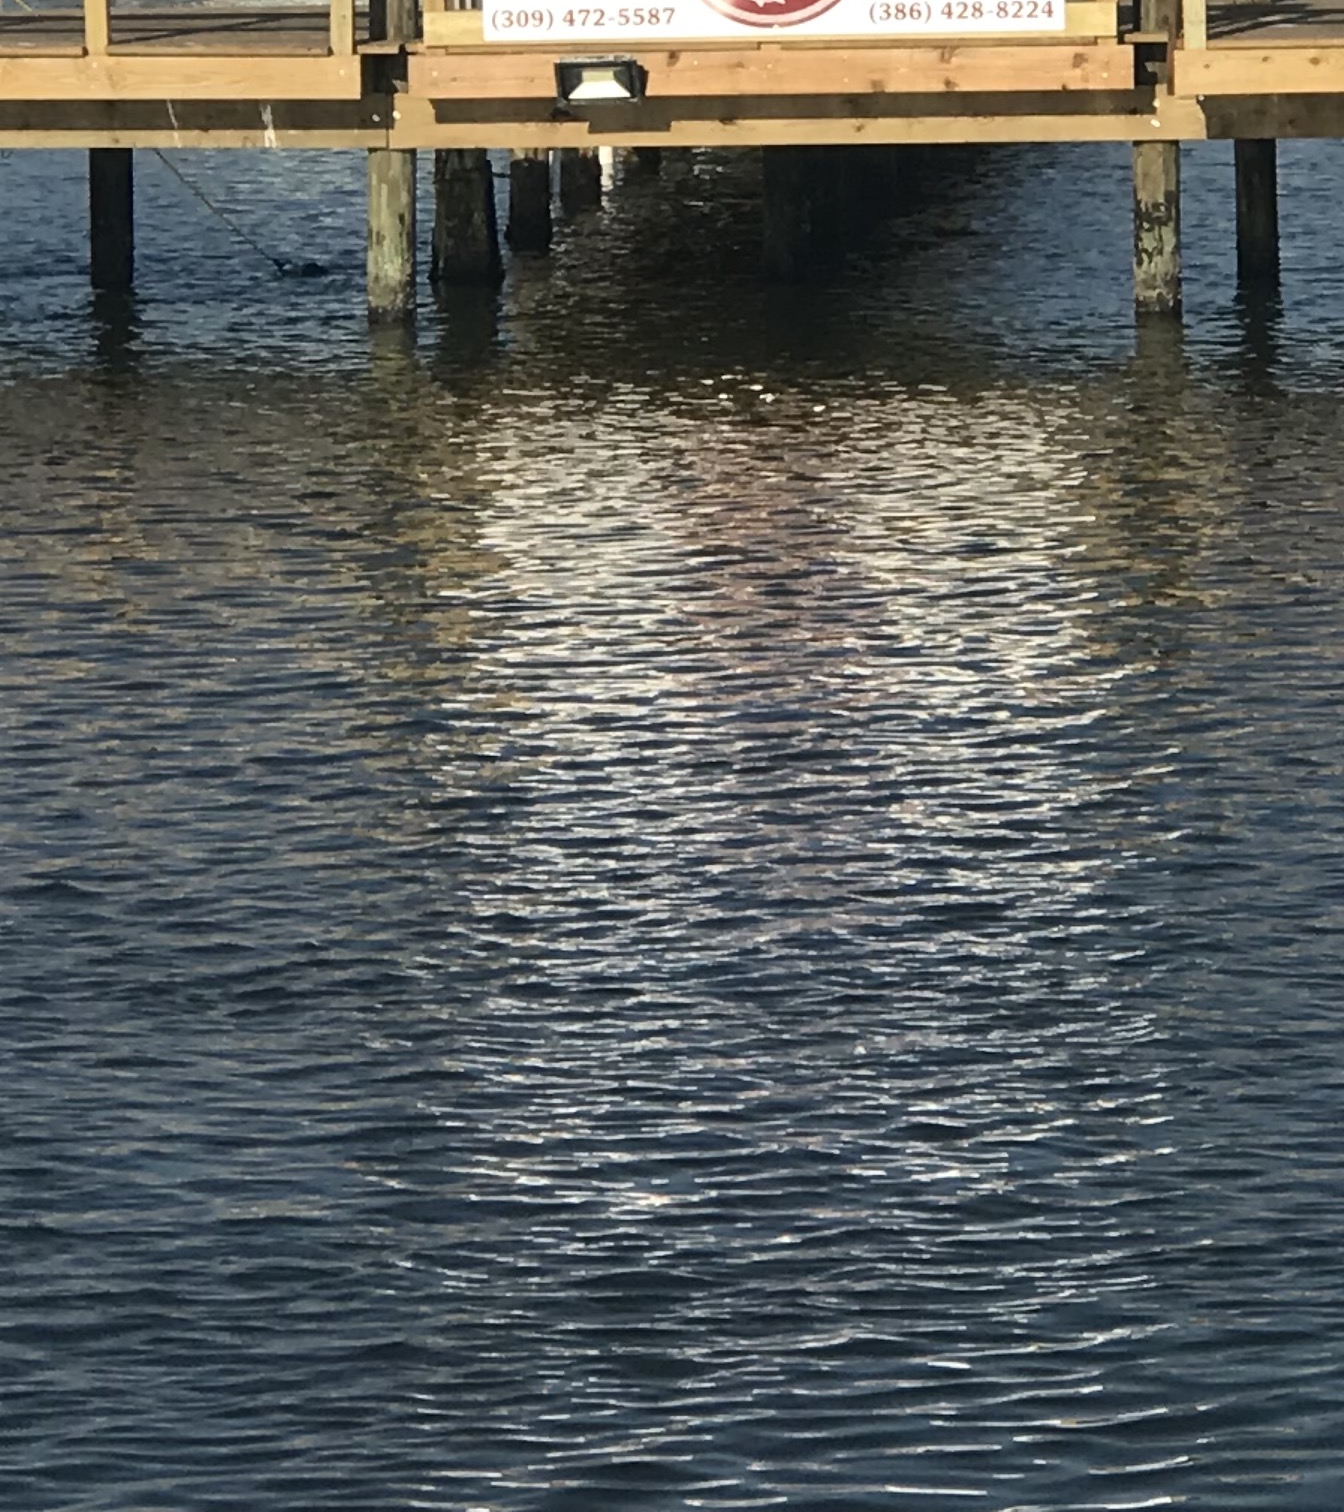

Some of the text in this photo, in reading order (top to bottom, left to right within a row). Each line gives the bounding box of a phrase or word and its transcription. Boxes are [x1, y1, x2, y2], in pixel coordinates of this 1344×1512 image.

[491, 7, 676, 31] (309) 472-5587
[869, 0, 1054, 24] (386) 428-8224
